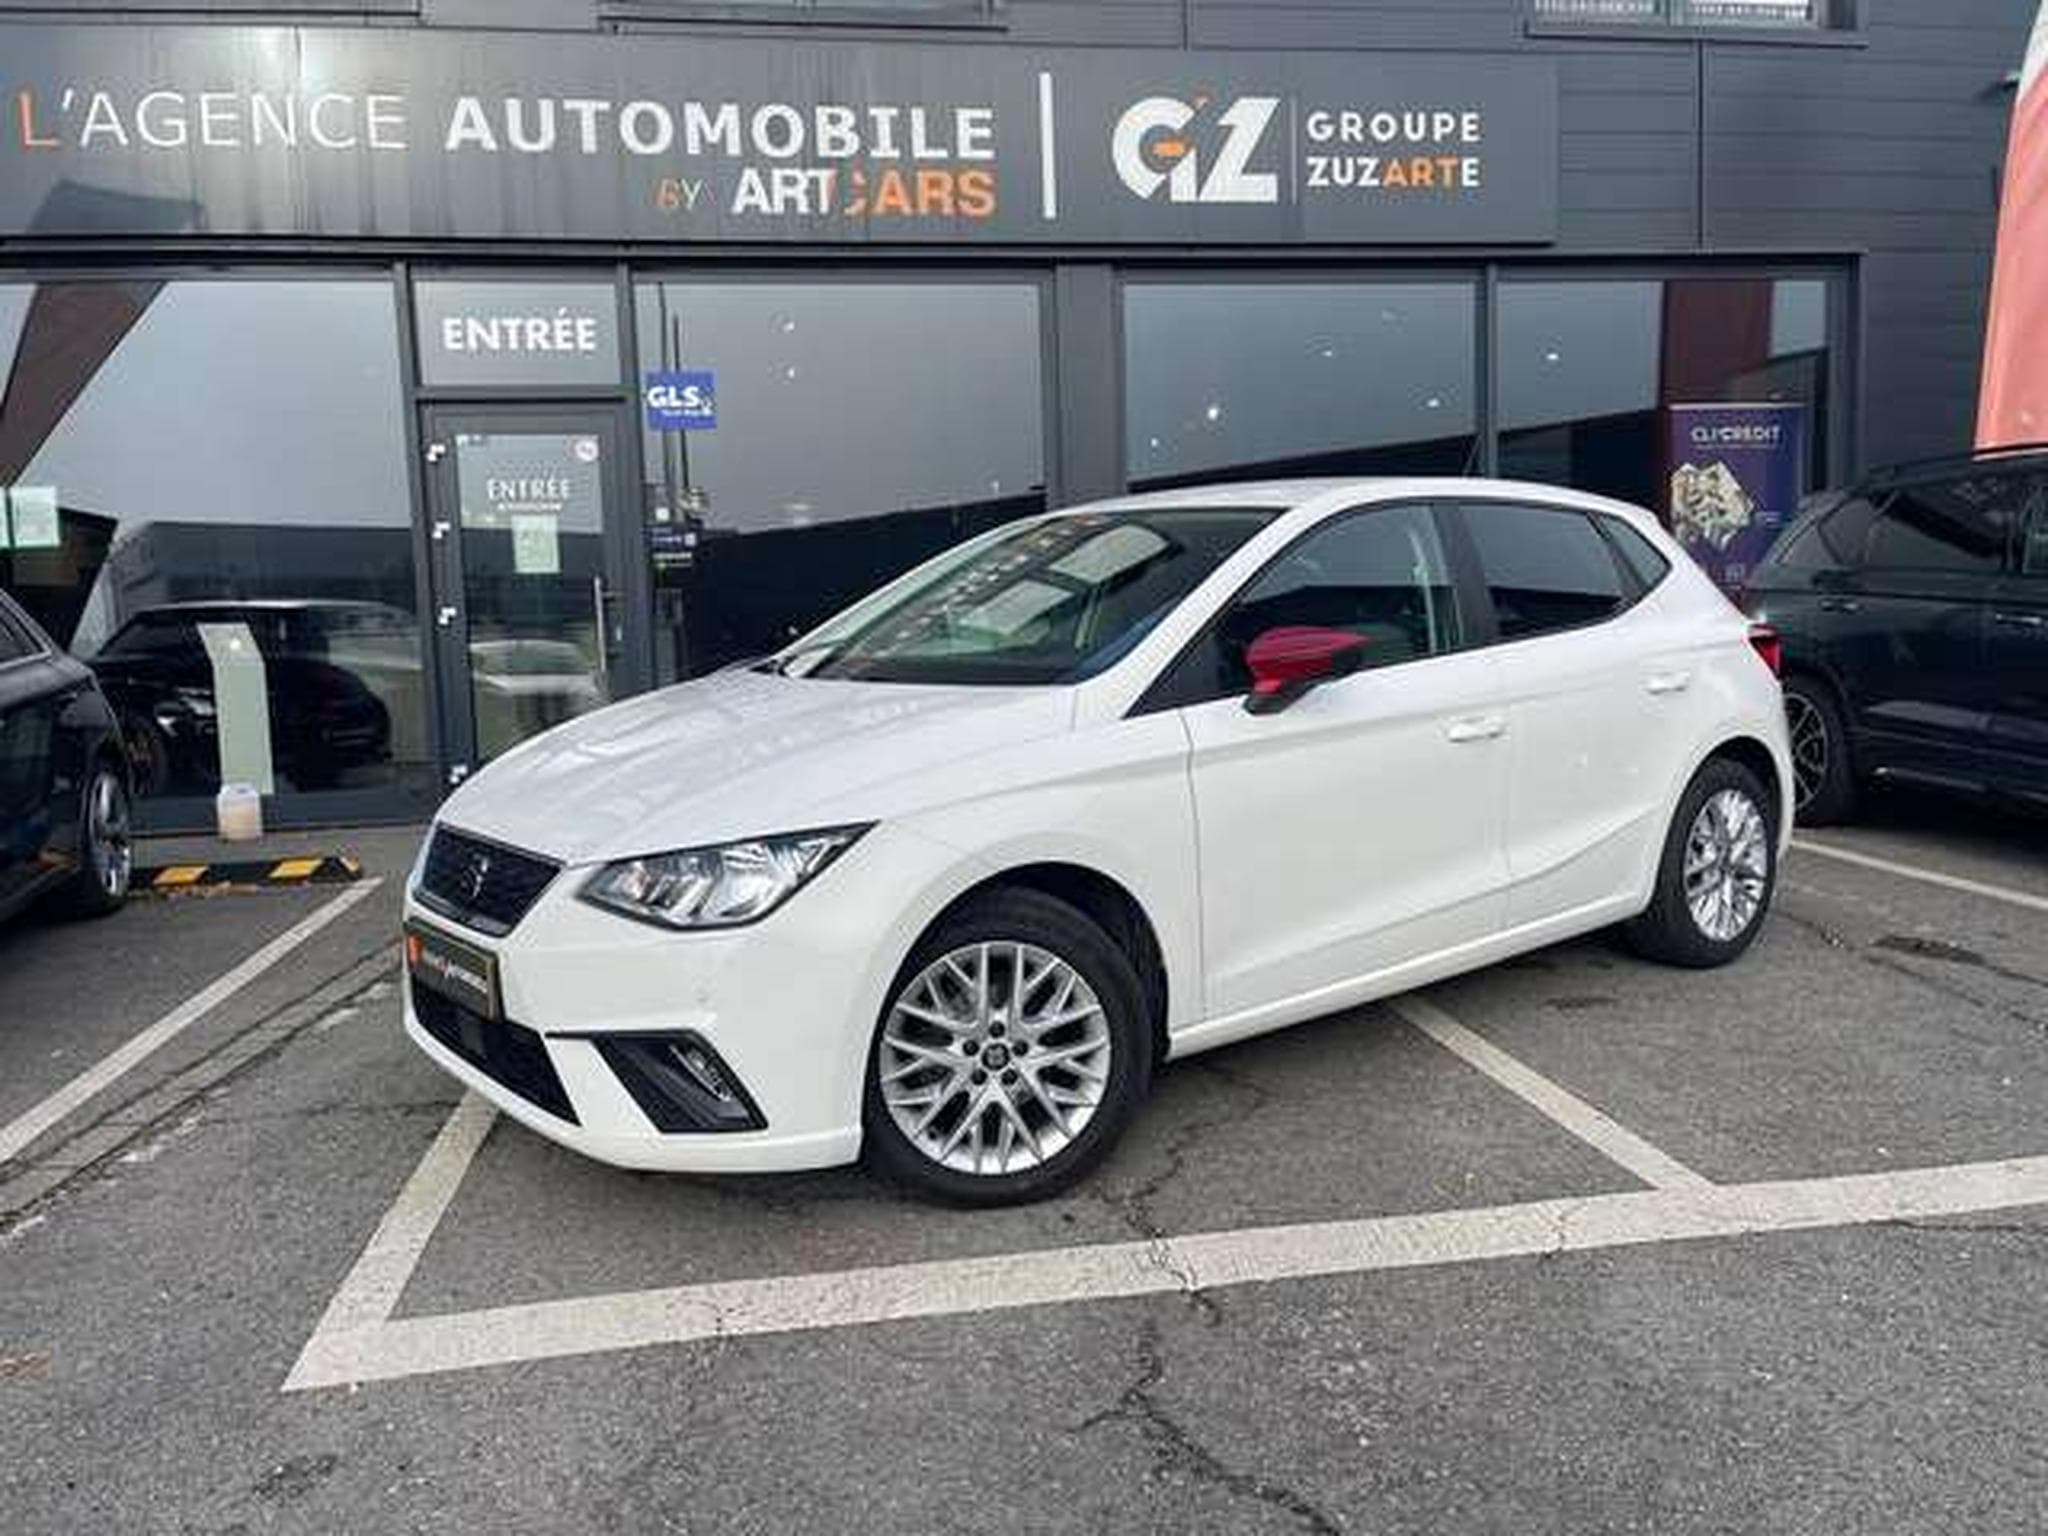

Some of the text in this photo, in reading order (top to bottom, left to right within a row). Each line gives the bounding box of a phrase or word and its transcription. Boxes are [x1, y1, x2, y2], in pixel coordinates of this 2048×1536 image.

[17, 89, 996, 160] L'AGENCE AUTOMOBILE
[1306, 111, 1482, 143] GROUPE
[1306, 156, 1482, 189] ZUZARTE
[443, 308, 597, 352] ENTRÉE
[647, 385, 701, 408] GLS
[486, 475, 571, 500] ENTRÉE
